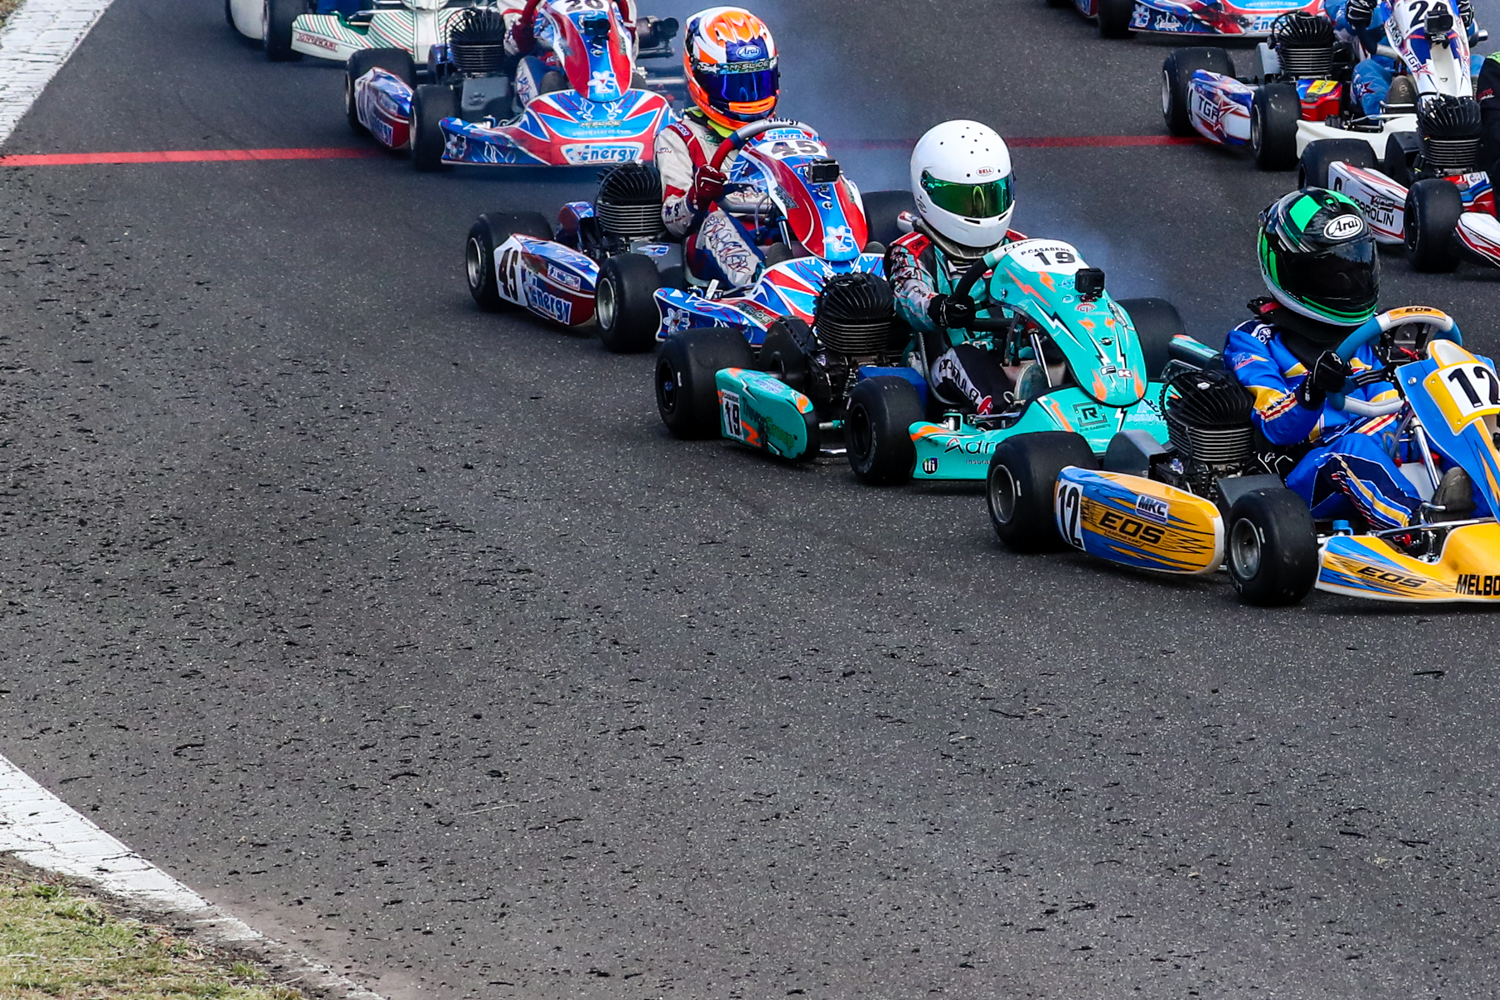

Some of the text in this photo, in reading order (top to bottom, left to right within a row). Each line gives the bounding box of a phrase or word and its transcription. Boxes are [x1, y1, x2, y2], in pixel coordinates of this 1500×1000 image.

[771, 141, 820, 157] 45
[1330, 218, 1359, 235] Arai
[1034, 250, 1077, 266] 19
[1138, 496, 1167, 516] MKC
[1058, 484, 1084, 549] 12
[1100, 511, 1166, 544] EOS
[1355, 566, 1426, 588] EOS
